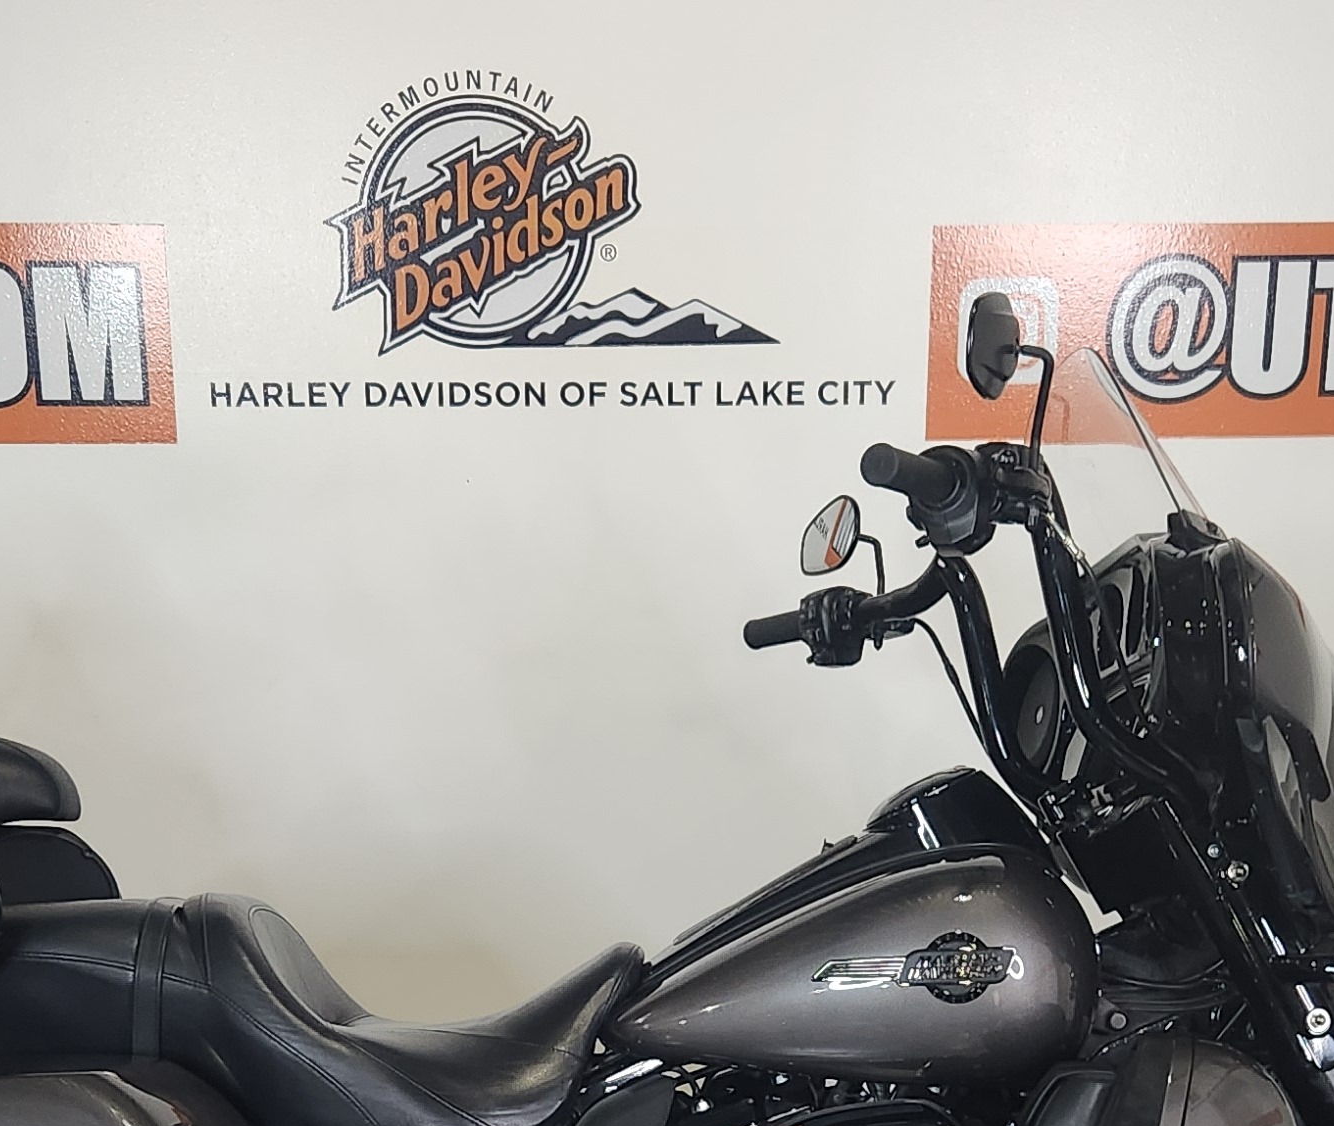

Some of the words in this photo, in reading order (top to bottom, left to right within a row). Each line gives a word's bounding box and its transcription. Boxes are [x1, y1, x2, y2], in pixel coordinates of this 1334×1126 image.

[341, 69, 555, 185] INTERMOUNTAIN
[391, 165, 627, 333] Davidson
[211, 382, 350, 407] HARLEY
[365, 382, 545, 407] DAVIDSON
[560, 382, 607, 407] OF
[620, 382, 702, 406] SALT
[717, 381, 804, 406] LAKE
[818, 381, 895, 405] CITY
